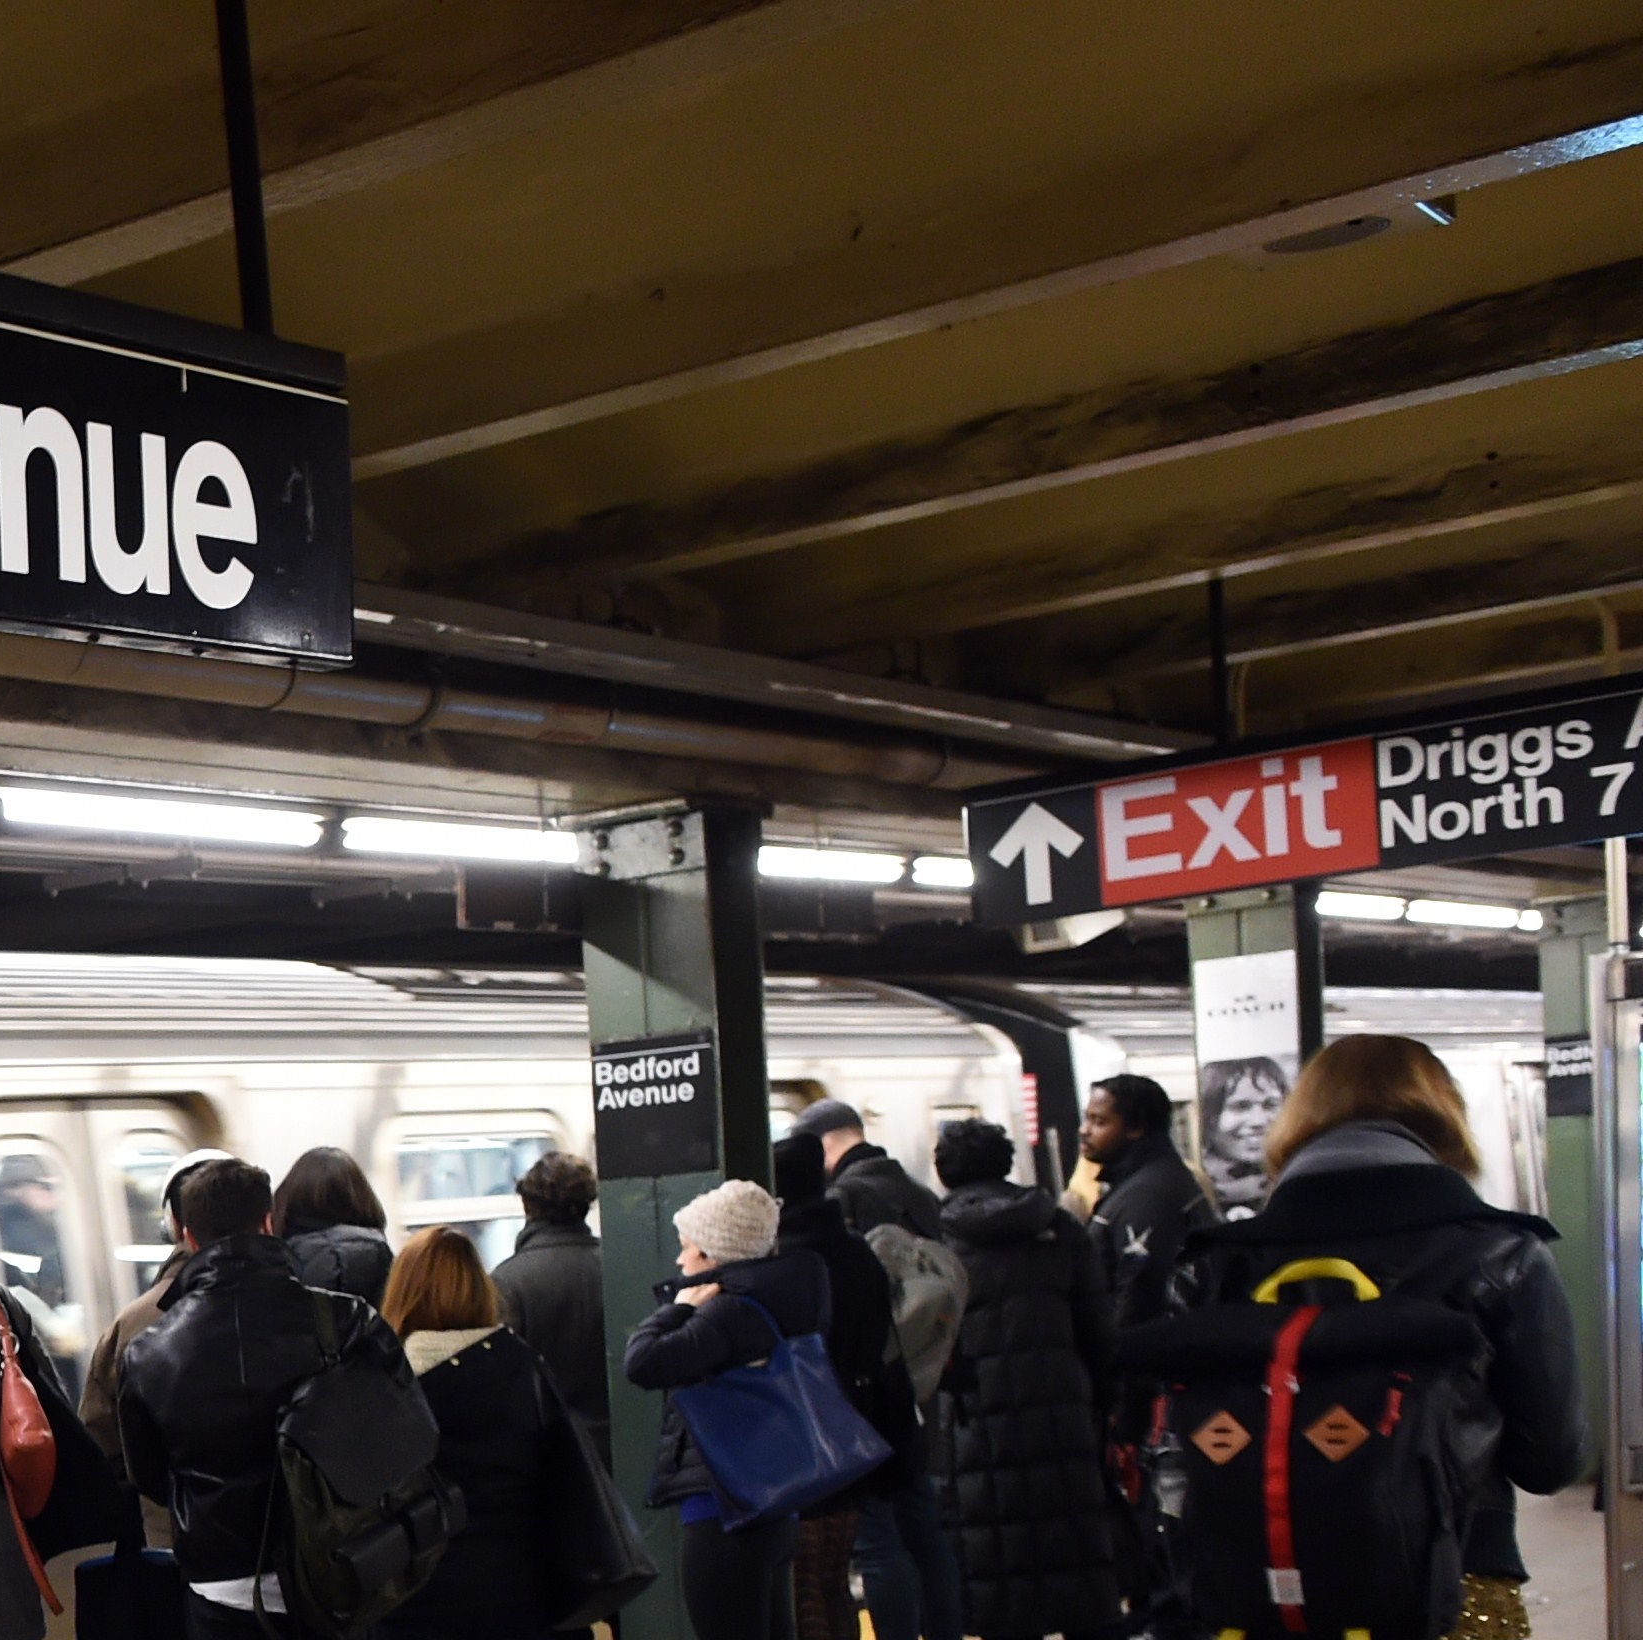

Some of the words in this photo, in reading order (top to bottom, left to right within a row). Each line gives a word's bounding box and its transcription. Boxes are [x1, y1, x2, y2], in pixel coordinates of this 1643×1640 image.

[1377, 719, 1595, 789] Driggs
[1100, 754, 1343, 883] Exit
[1379, 776, 1565, 849] North
[1589, 761, 1635, 817] 7
[594, 1050, 701, 1087] Bedford
[597, 1081, 696, 1112] Avenue
